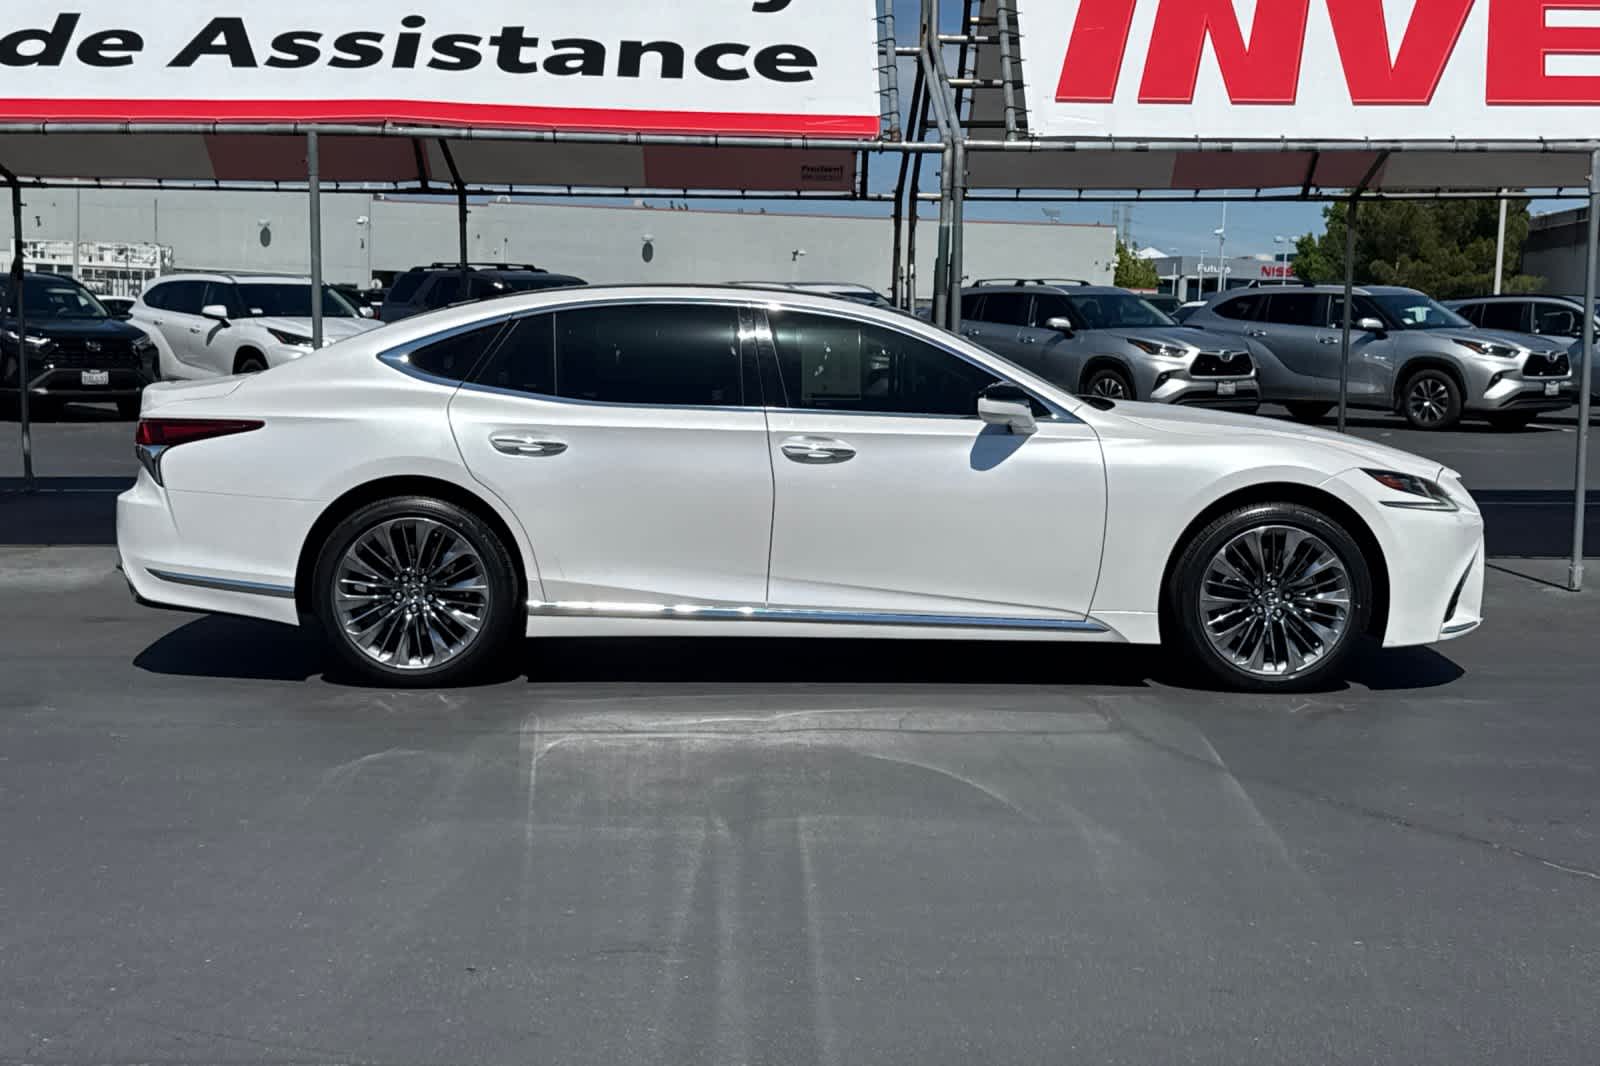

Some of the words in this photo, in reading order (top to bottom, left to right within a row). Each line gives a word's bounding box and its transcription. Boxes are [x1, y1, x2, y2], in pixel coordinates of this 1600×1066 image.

[0, 12, 145, 68] de
[167, 14, 818, 83] Assistance
[1055, 0, 1600, 105] INVE
